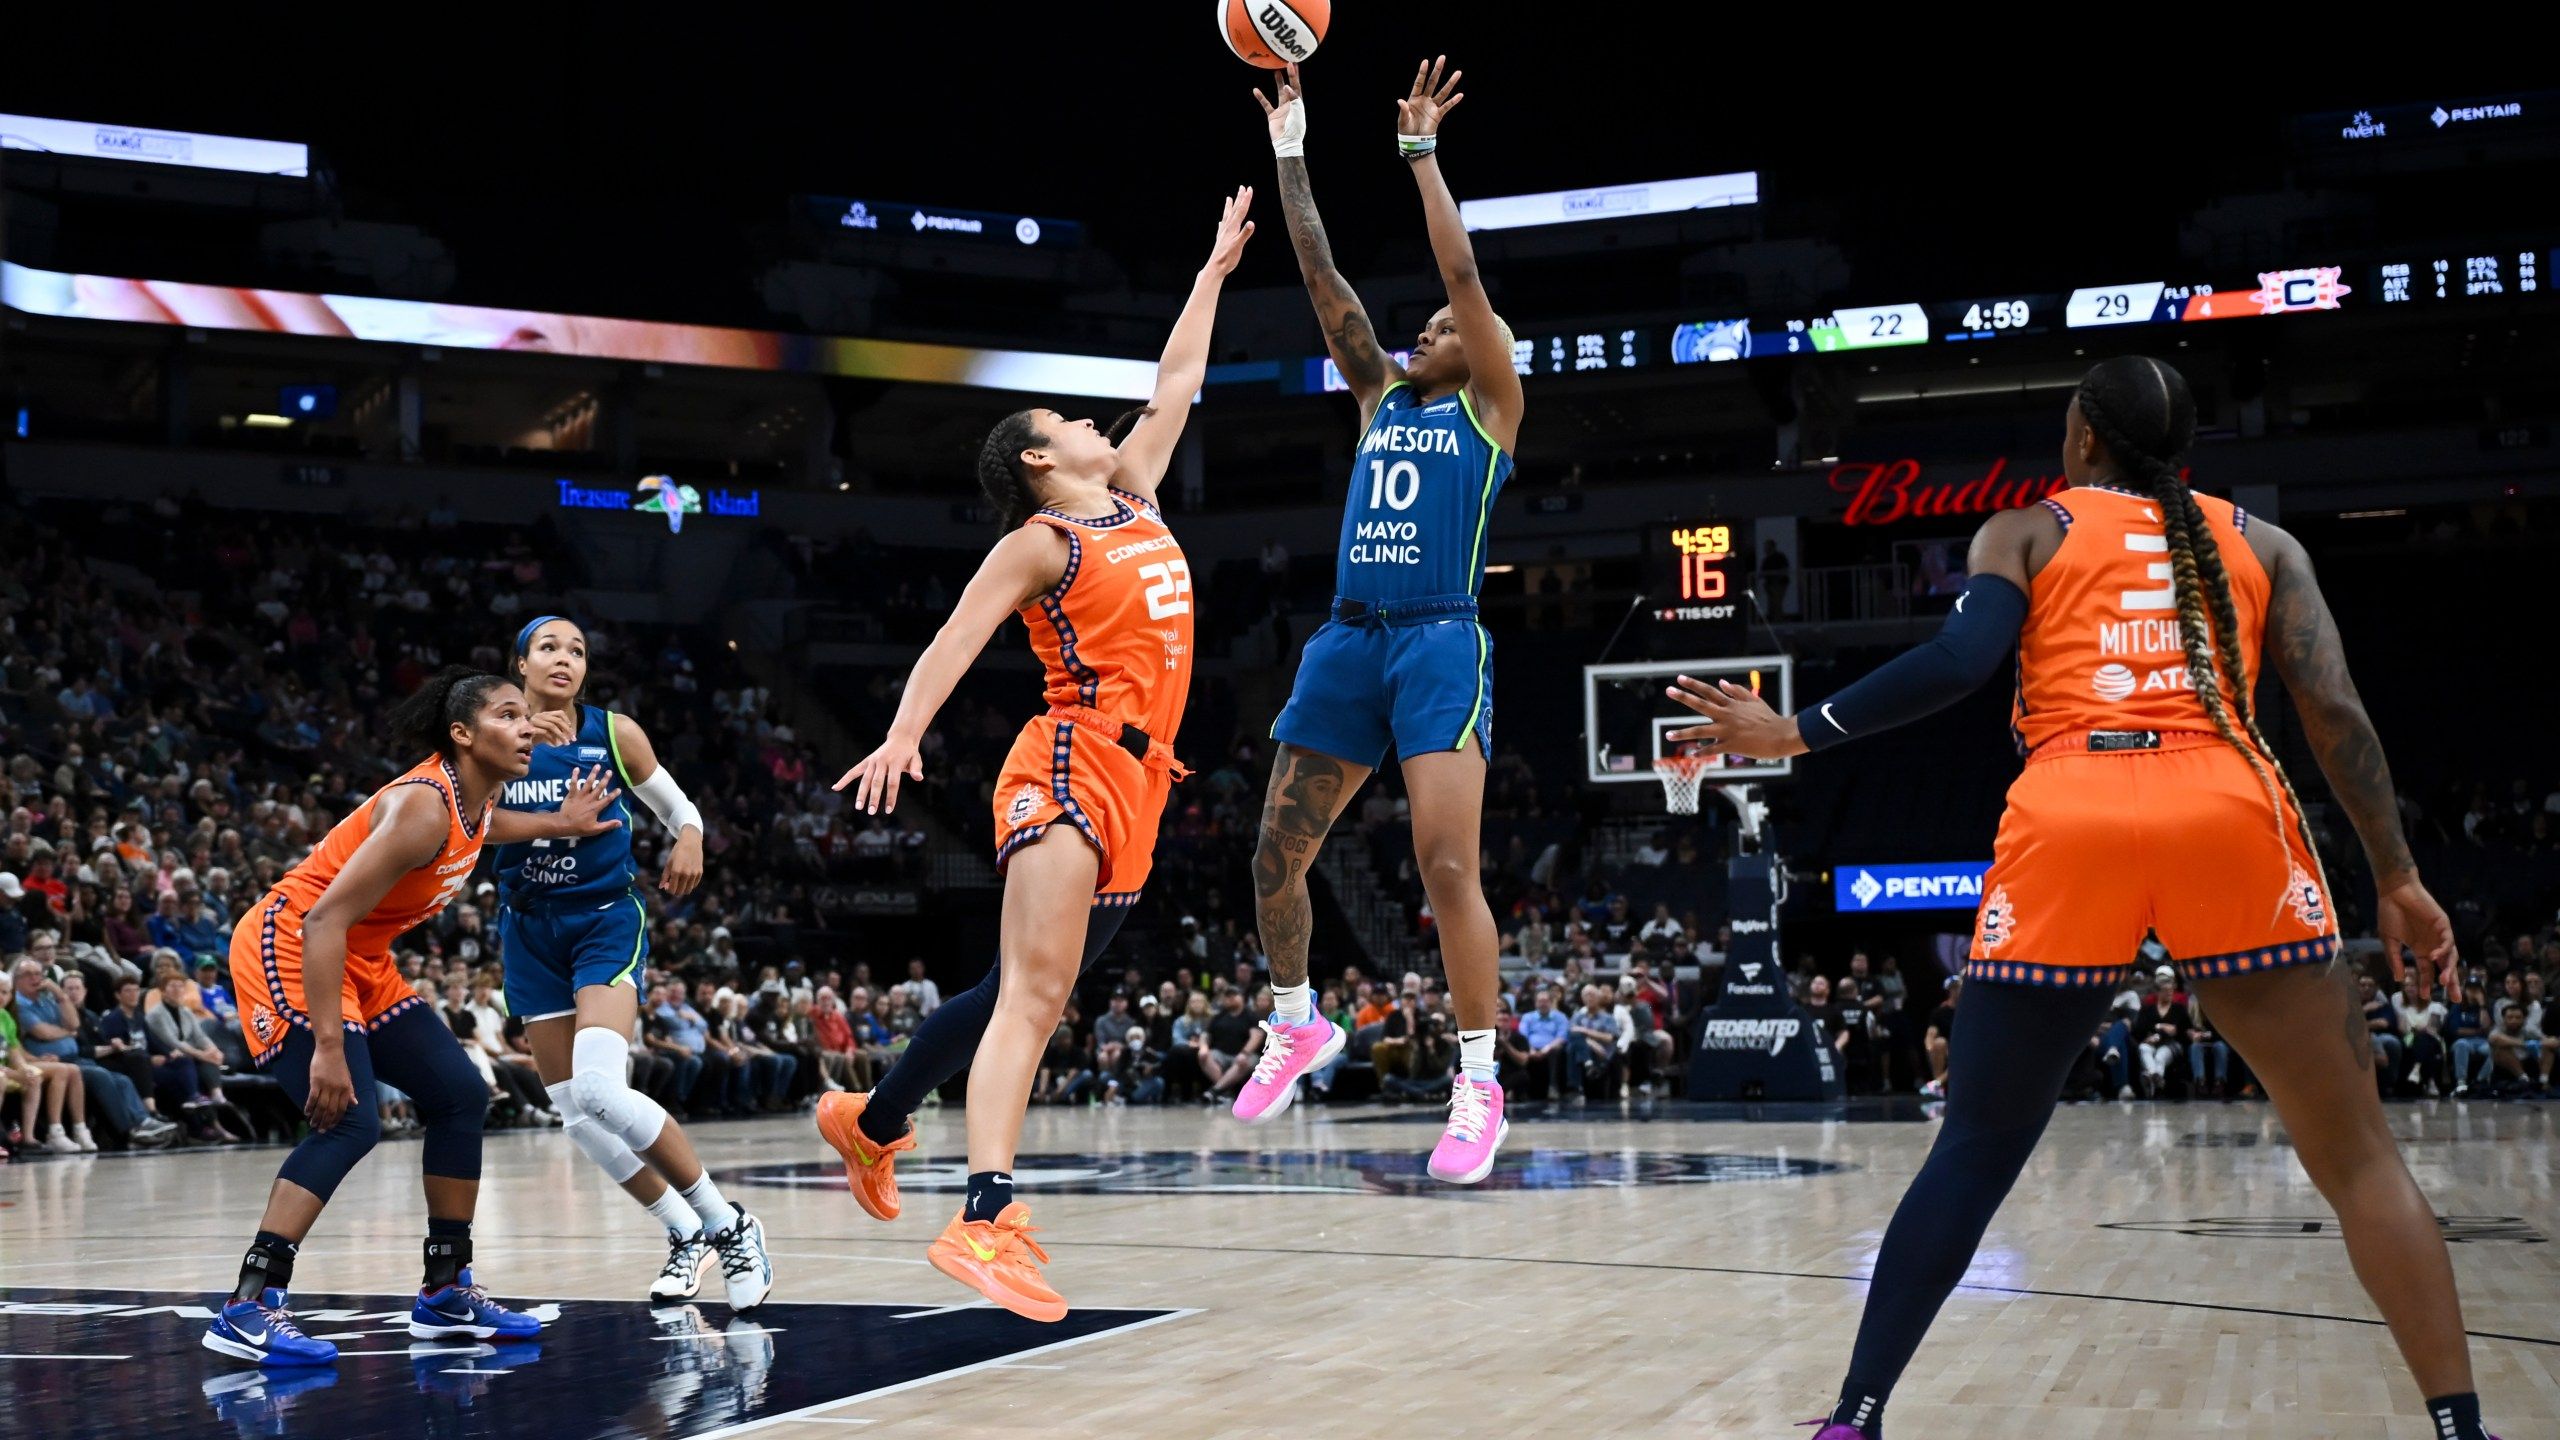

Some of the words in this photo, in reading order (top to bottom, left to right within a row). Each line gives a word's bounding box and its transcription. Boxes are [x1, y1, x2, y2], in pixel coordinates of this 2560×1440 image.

[1259, 3, 1308, 59] Wilson
[2451, 103, 2521, 122] PENTAIR
[2195, 284, 2213, 297] TO
[2436, 285, 2446, 298] 4
[1962, 300, 2030, 331] 4:59
[2095, 294, 2131, 318] 29
[2167, 305, 2176, 320] 1
[2199, 302, 2212, 317] 4
[1870, 313, 1902, 337] 22
[1788, 336, 1800, 352] 3
[556, 479, 630, 510] Treasure
[1370, 460, 1420, 511] 10
[707, 489, 759, 517] Island
[1357, 521, 1417, 540] MAYO
[1672, 526, 1730, 555] 4:59
[1350, 545, 1421, 564] CLINIC
[1681, 552, 1726, 600] 16
[1138, 559, 1190, 621] 22
[1676, 605, 1735, 620] TISSOT
[521, 865, 579, 885] CLINIC
[1727, 983, 1774, 995] Fanatics
[1703, 1018, 1800, 1039] FEDERATED
